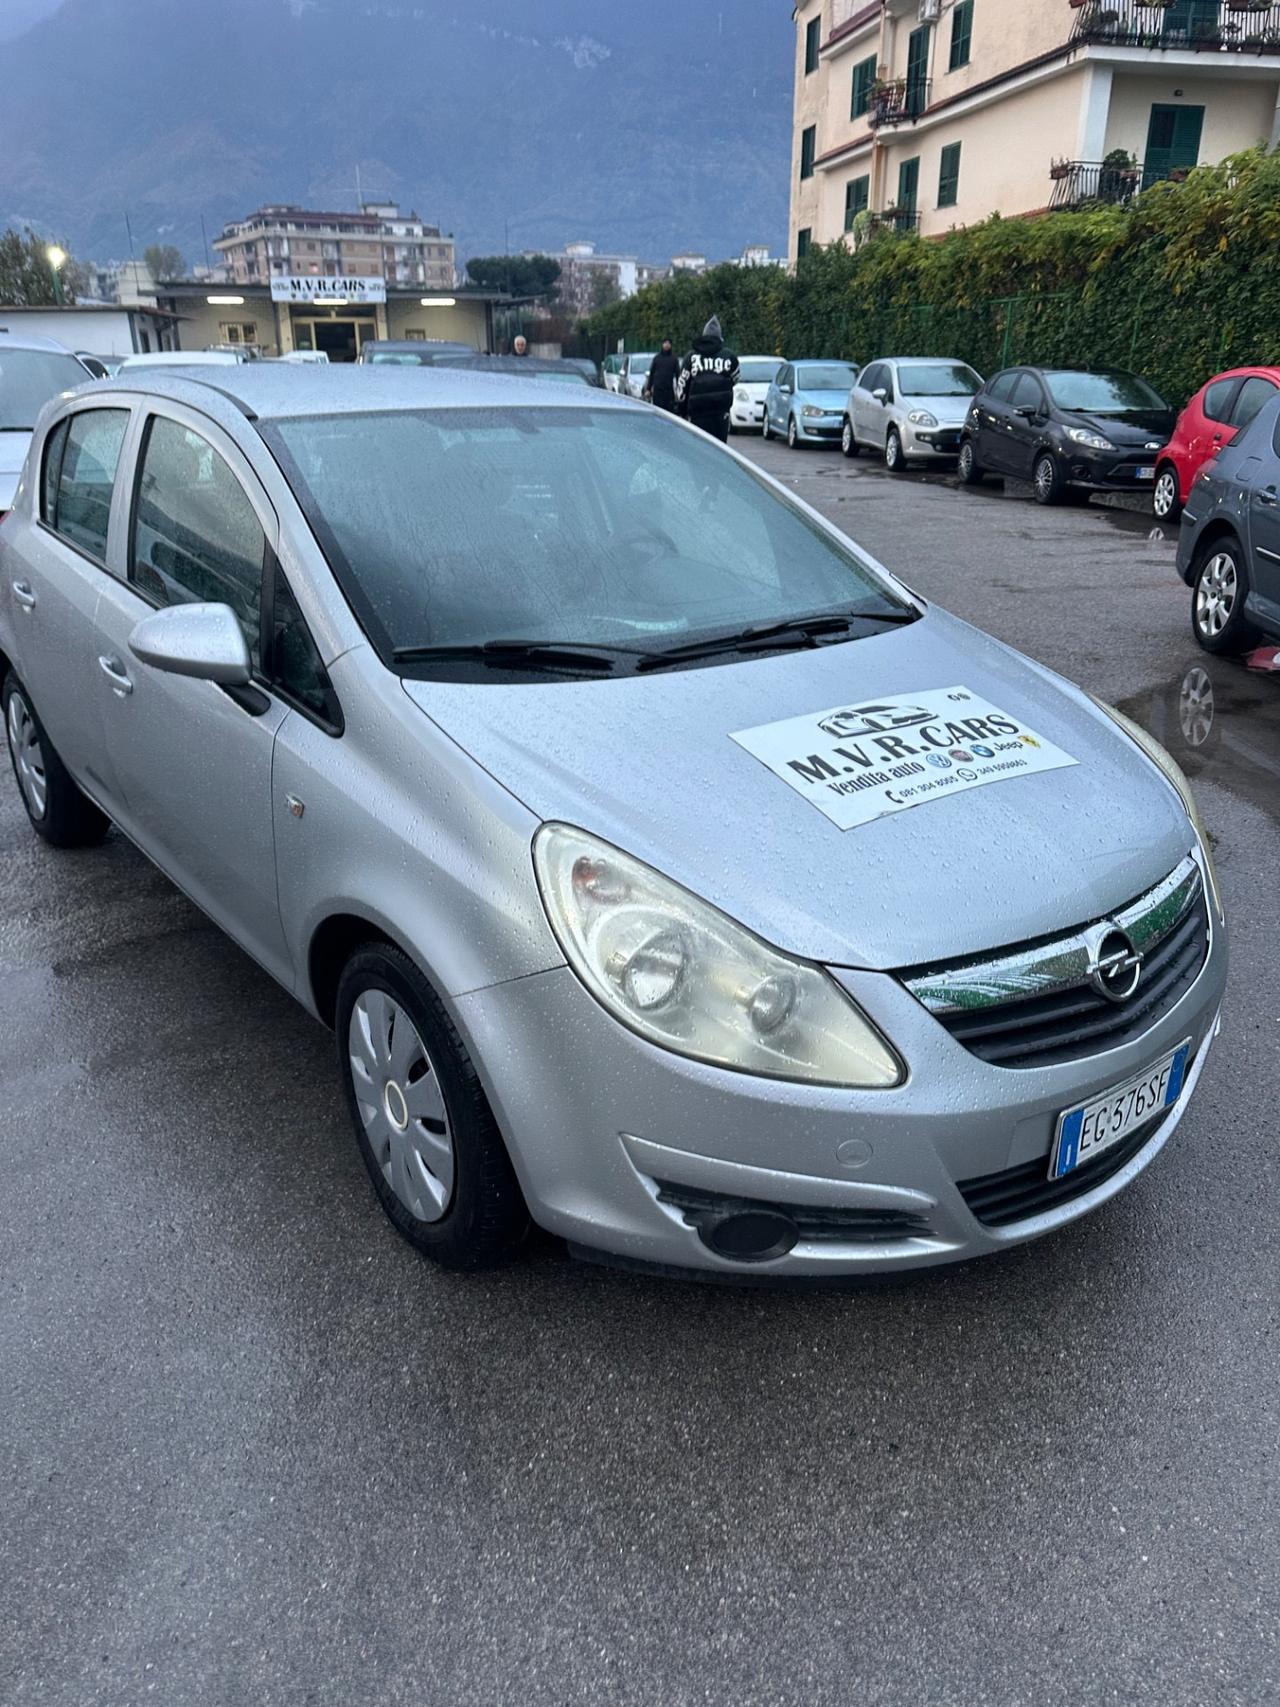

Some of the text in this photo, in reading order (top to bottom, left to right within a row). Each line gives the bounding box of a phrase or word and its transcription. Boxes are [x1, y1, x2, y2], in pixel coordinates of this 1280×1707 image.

[993, 741, 1023, 752] Jeep
[826, 761, 925, 796] Vendita auto
[899, 787, 918, 797] 081
